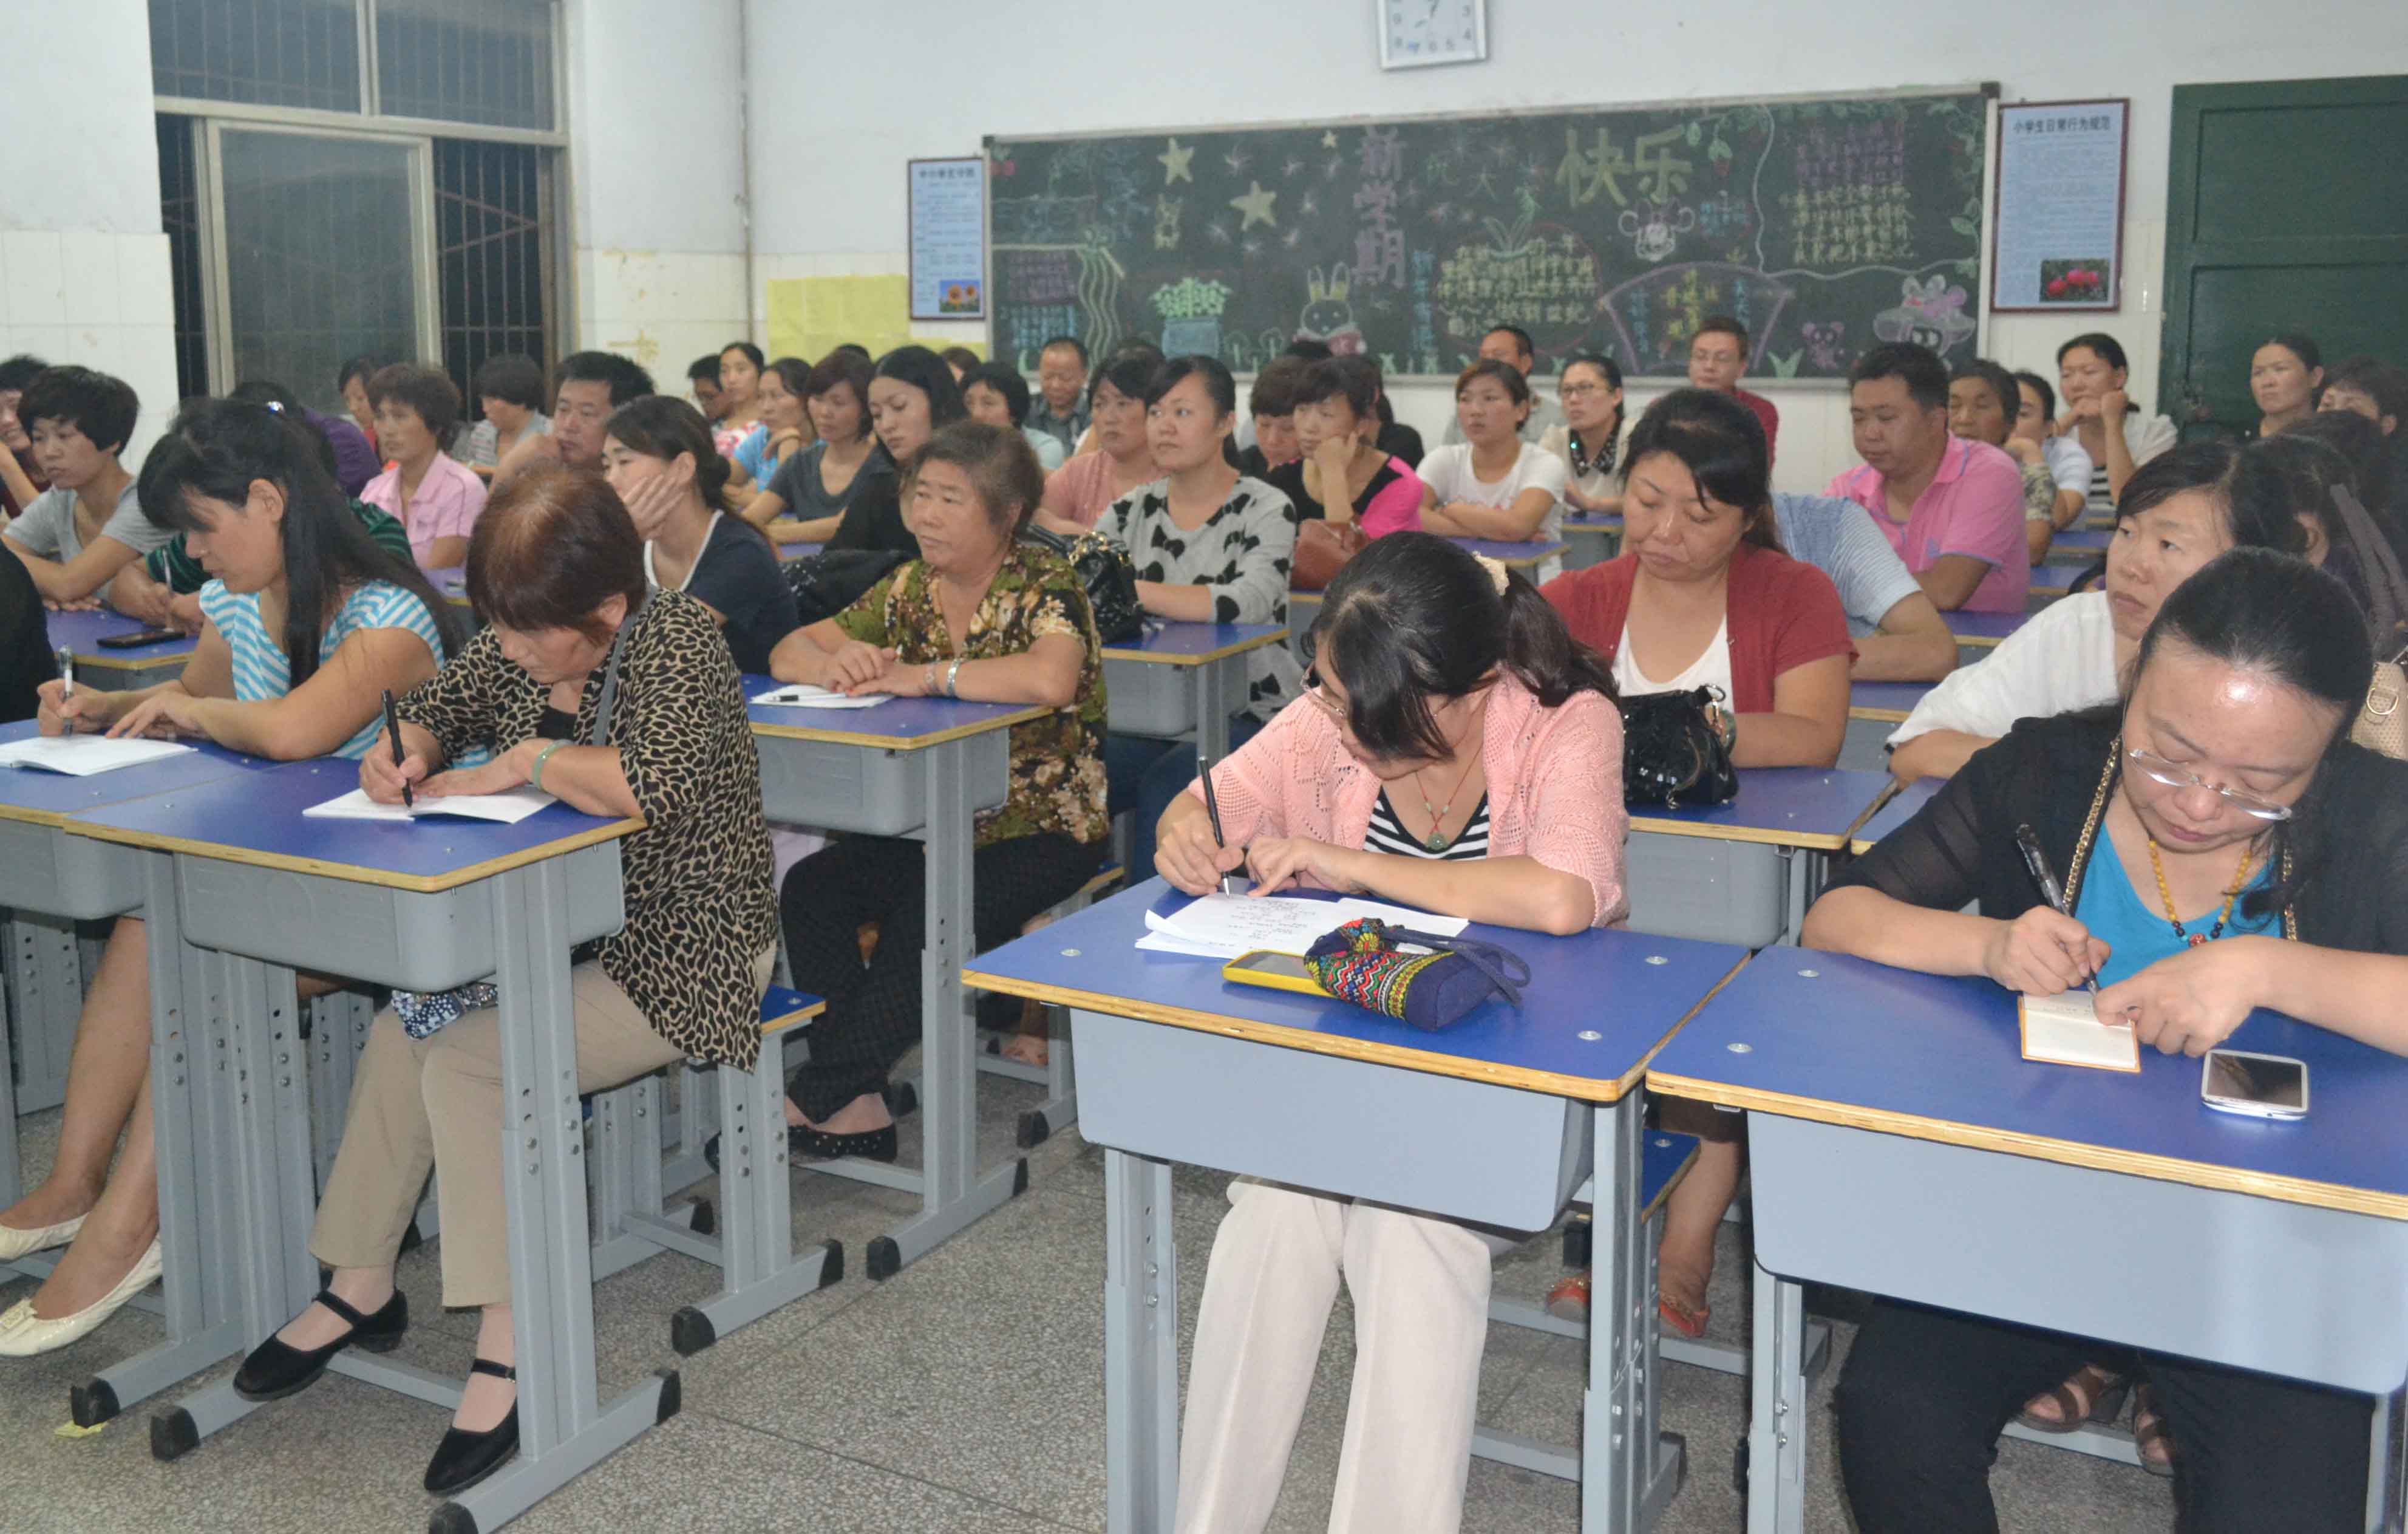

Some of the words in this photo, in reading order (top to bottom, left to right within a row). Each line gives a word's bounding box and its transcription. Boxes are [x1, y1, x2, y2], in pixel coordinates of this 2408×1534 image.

[1554, 124, 1693, 208] 快乐
[2013, 115, 2110, 134] 小学生日常行为规范
[1350, 125, 1407, 289] 新学期
